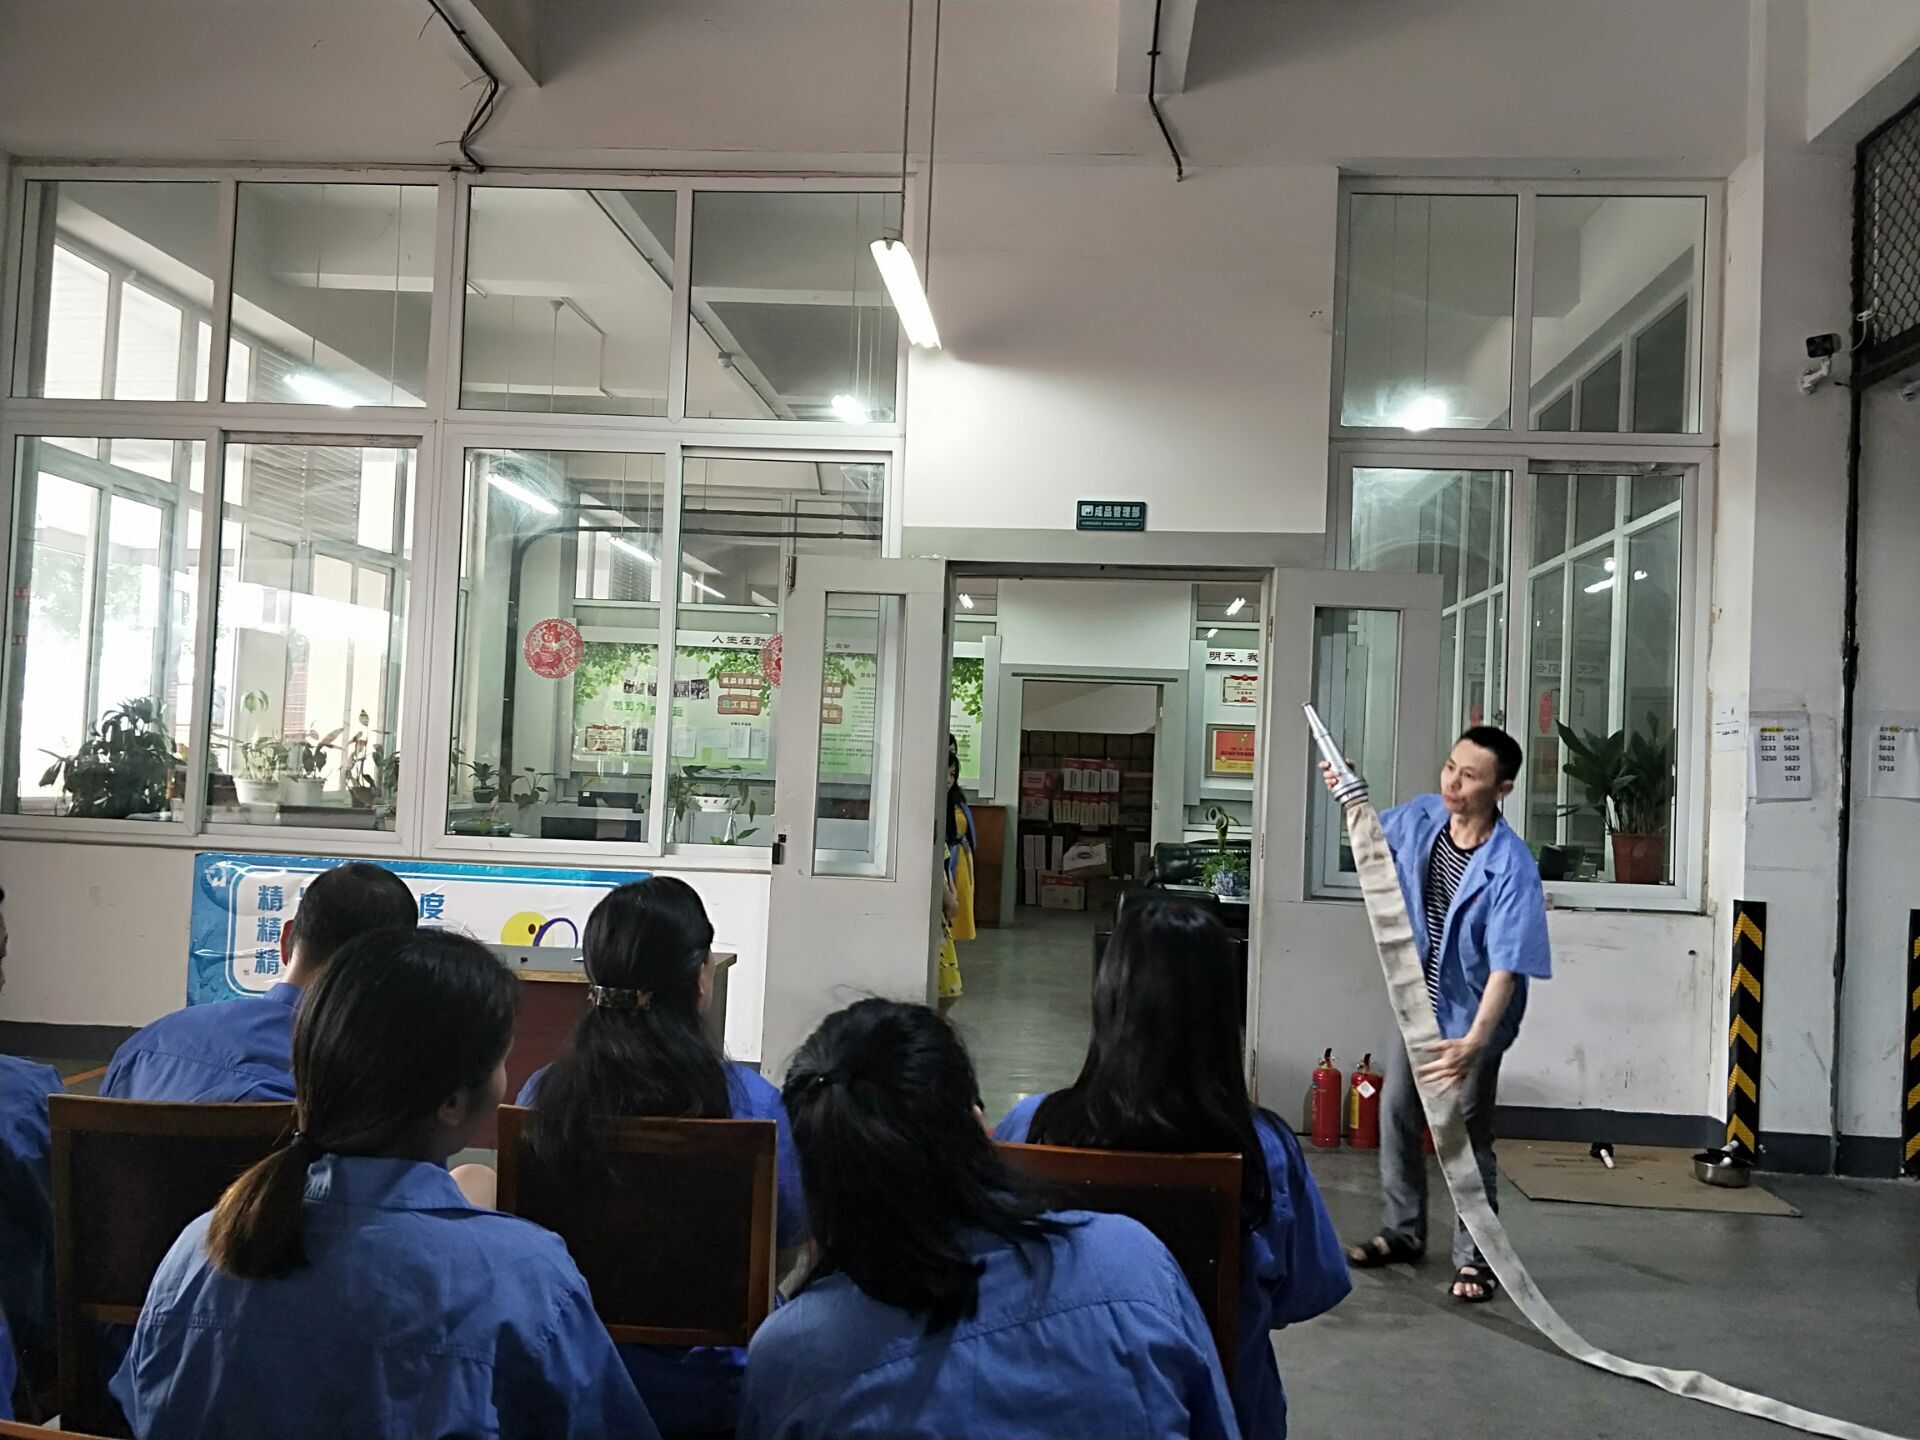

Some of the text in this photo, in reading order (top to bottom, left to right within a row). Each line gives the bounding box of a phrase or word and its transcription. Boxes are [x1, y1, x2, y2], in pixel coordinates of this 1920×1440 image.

[1094, 505, 1140, 518] 成品管理部
[258, 885, 445, 920] 精 度
[256, 917, 282, 944] 精
[254, 948, 280, 975] 精
